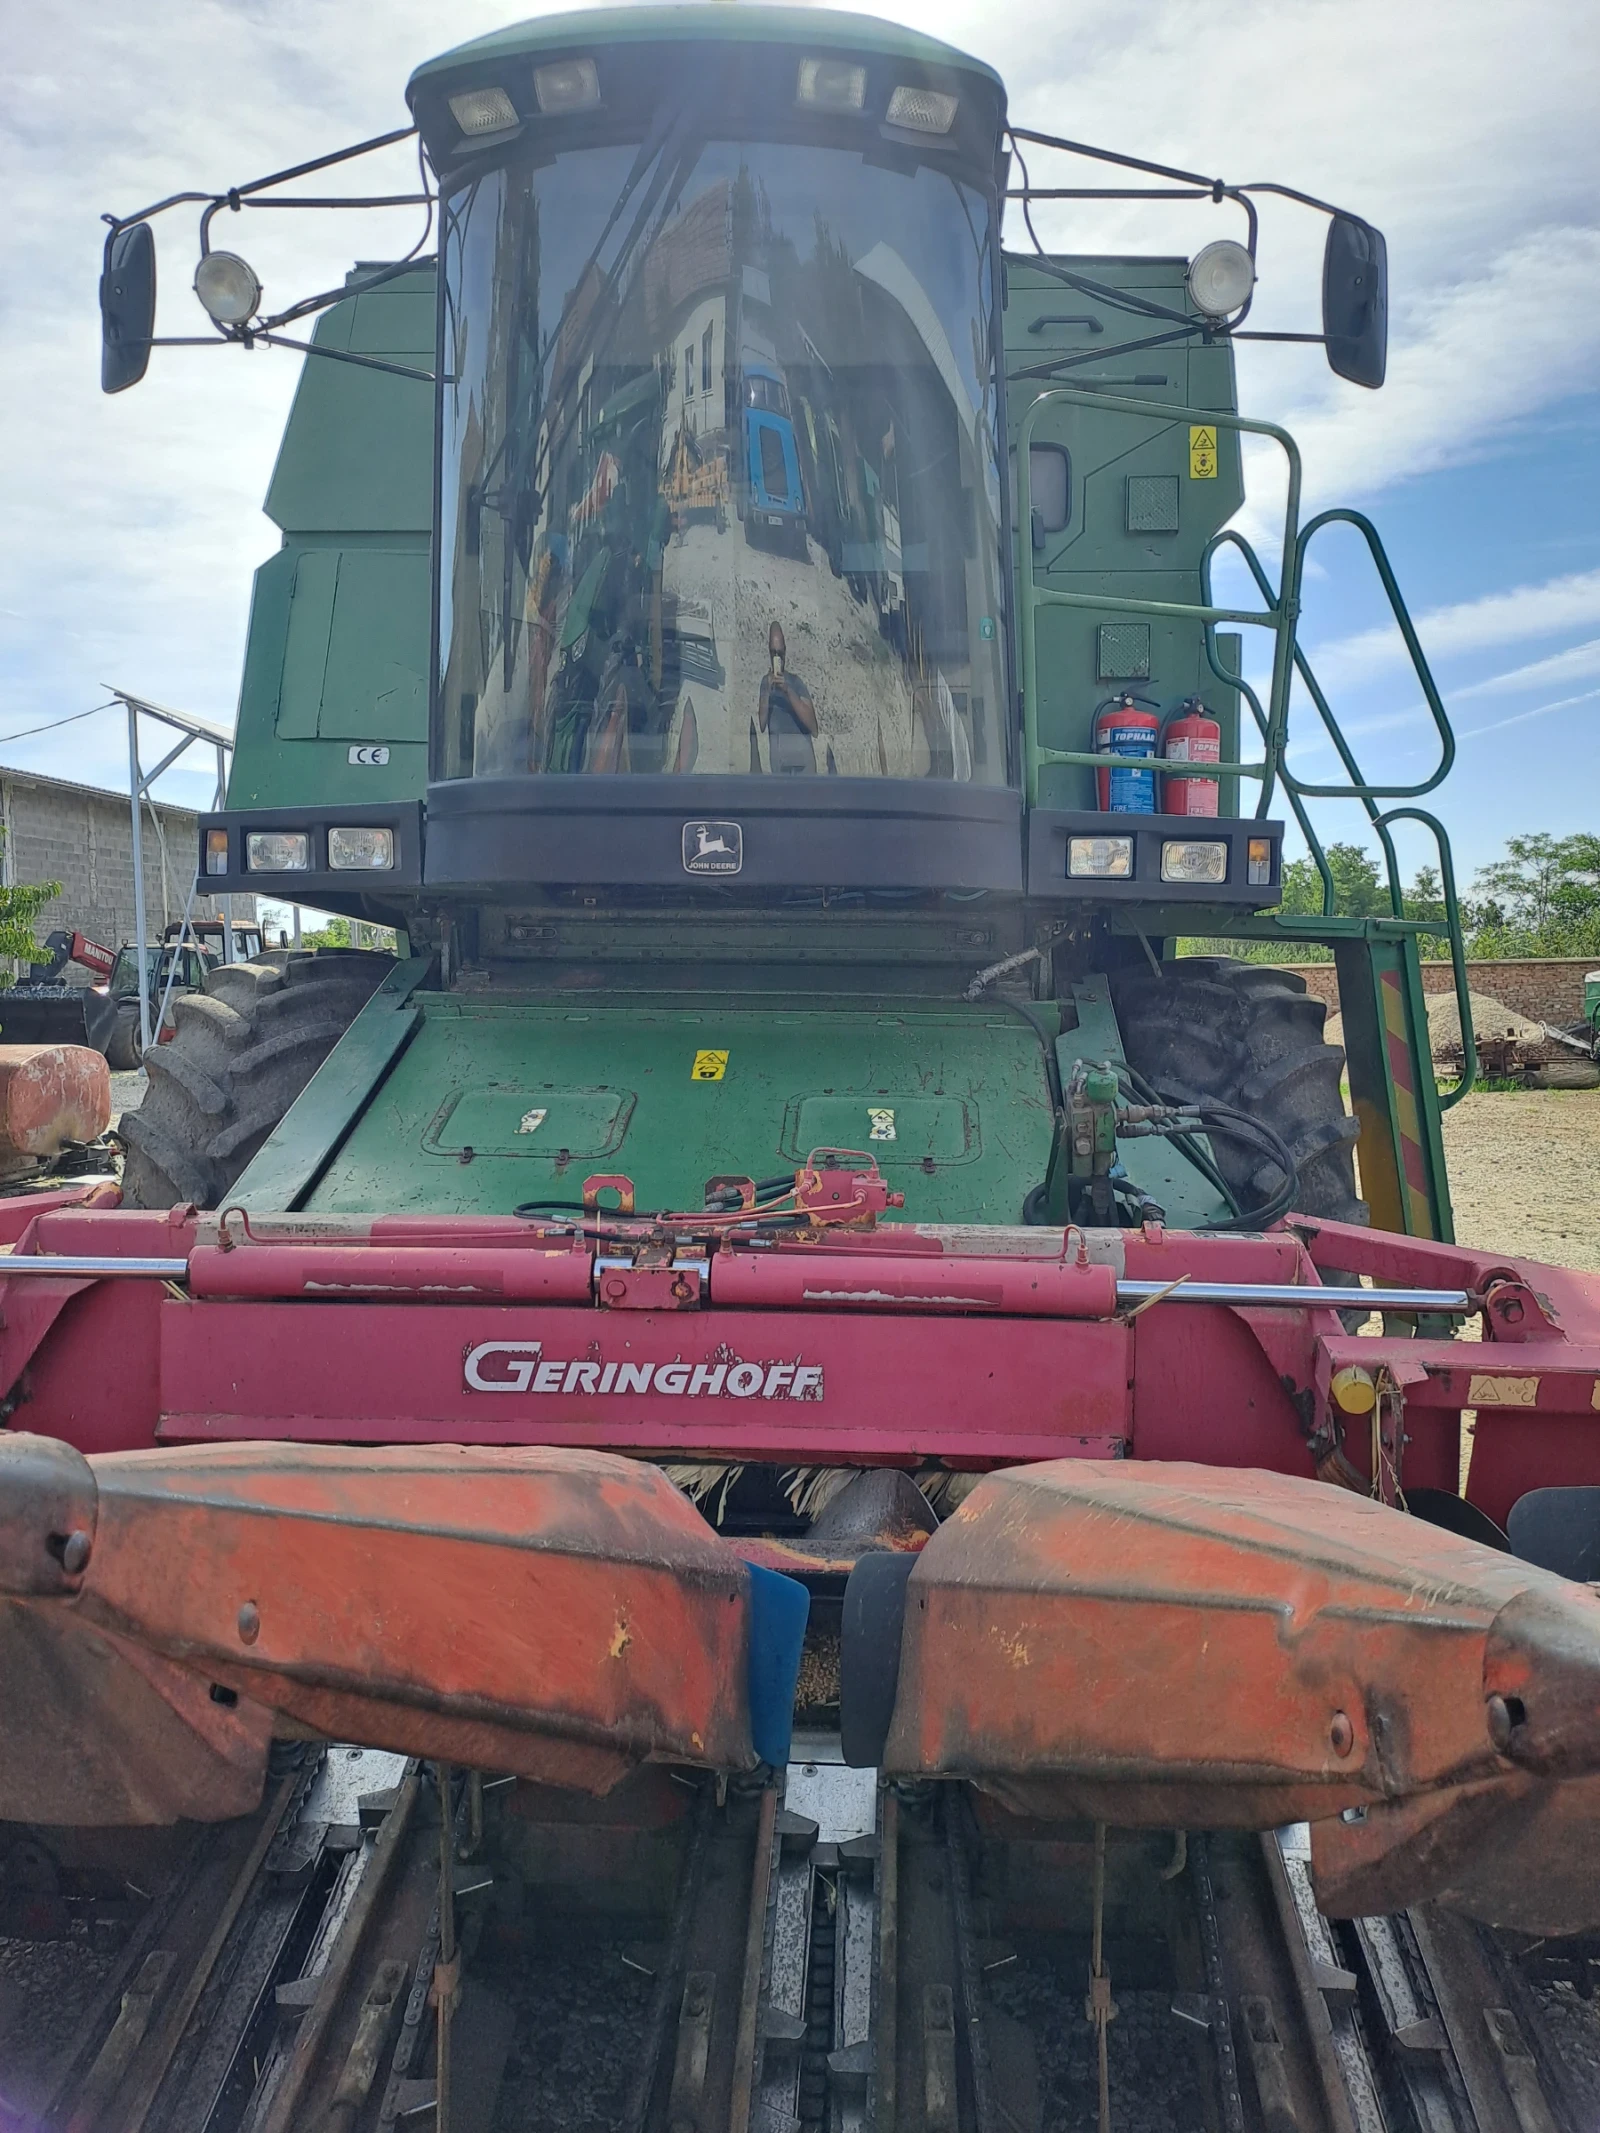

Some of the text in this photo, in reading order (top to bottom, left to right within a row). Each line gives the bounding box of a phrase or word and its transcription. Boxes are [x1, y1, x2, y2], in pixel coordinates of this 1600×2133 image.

[357, 748, 382, 763] CE
[688, 862, 737, 870] JOHN DEERE
[83, 942, 114, 966] MANITOU
[464, 1340, 823, 1398] GERINGHOFF
